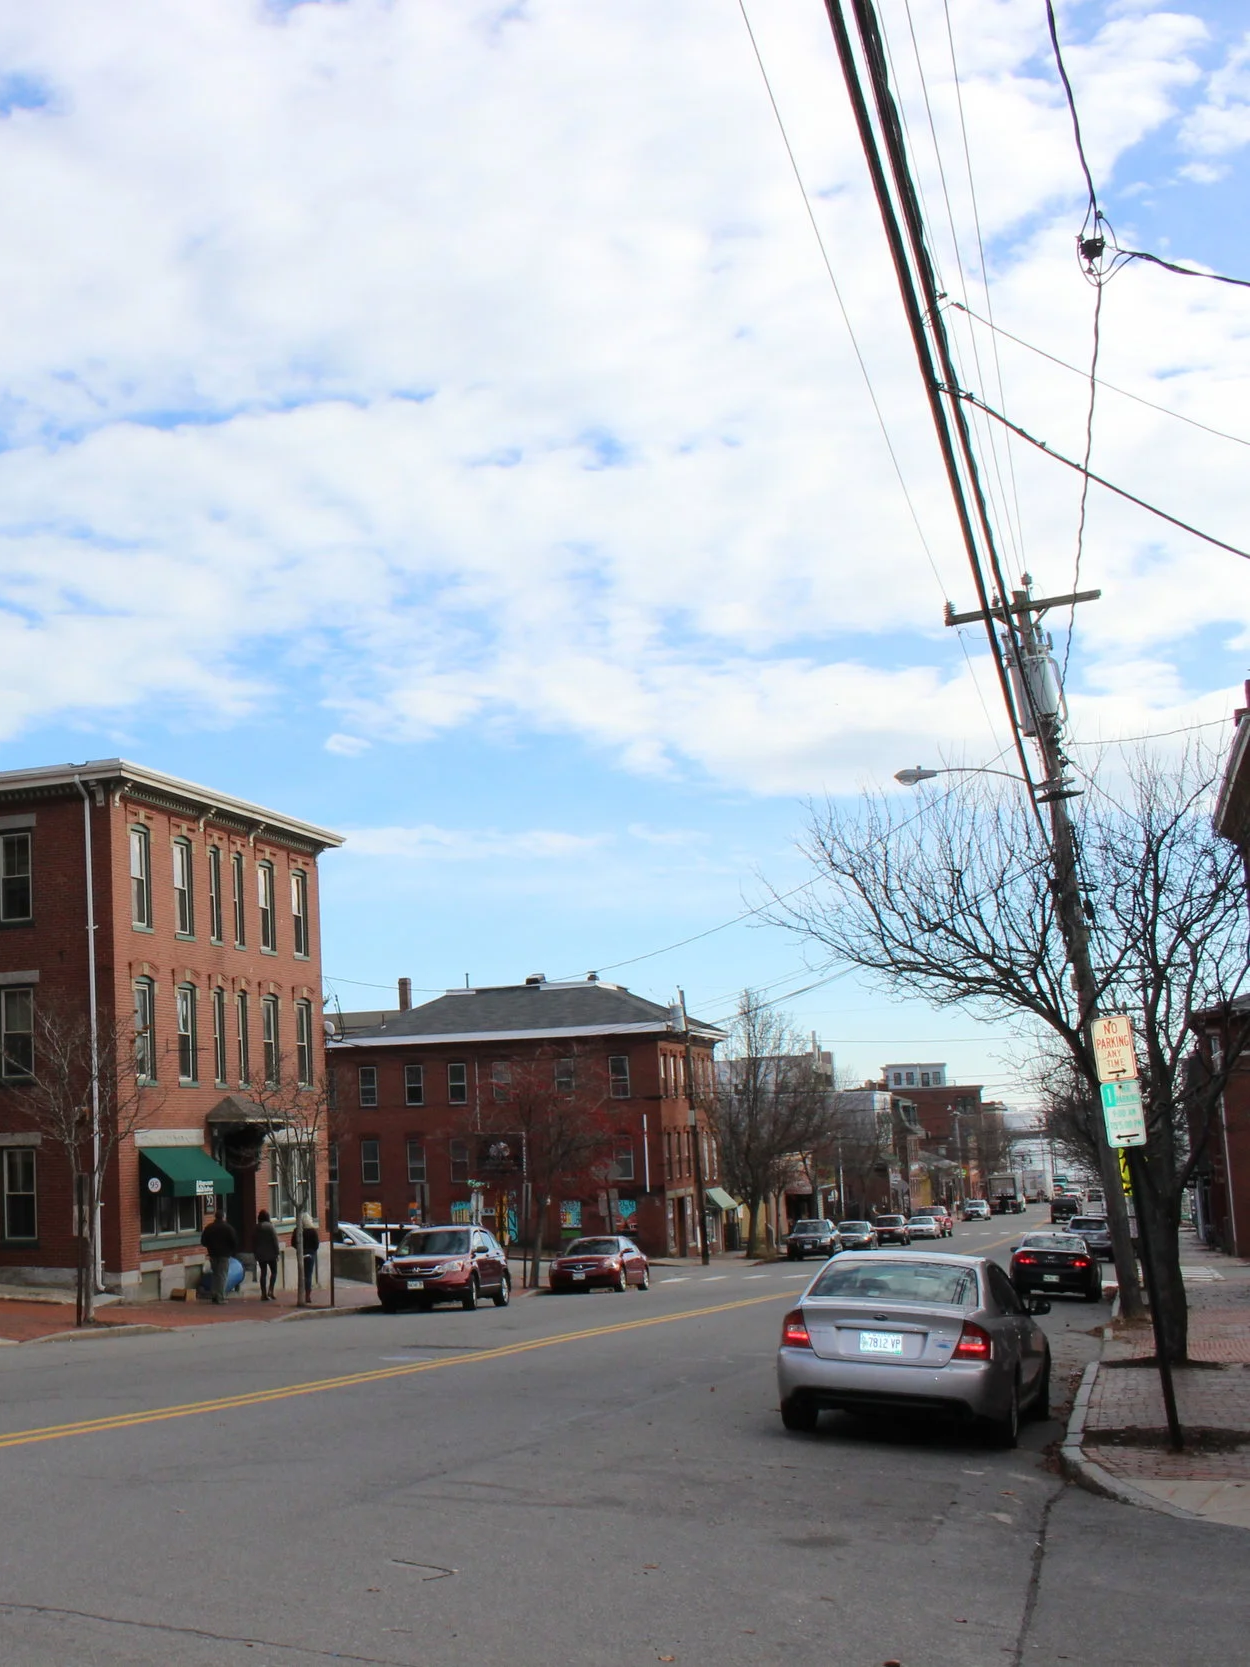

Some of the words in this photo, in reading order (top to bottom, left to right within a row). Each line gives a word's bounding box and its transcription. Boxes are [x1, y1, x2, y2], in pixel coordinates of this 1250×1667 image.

[1103, 1022, 1118, 1034] NO
[1096, 1034, 1129, 1049] PARKING
[1107, 1050, 1122, 1058] ANY
[1106, 1058, 1126, 1068] TIME
[150, 1181, 159, 1189] 95
[868, 1336, 888, 1349] 7812
[891, 1338, 901, 1349] VP
